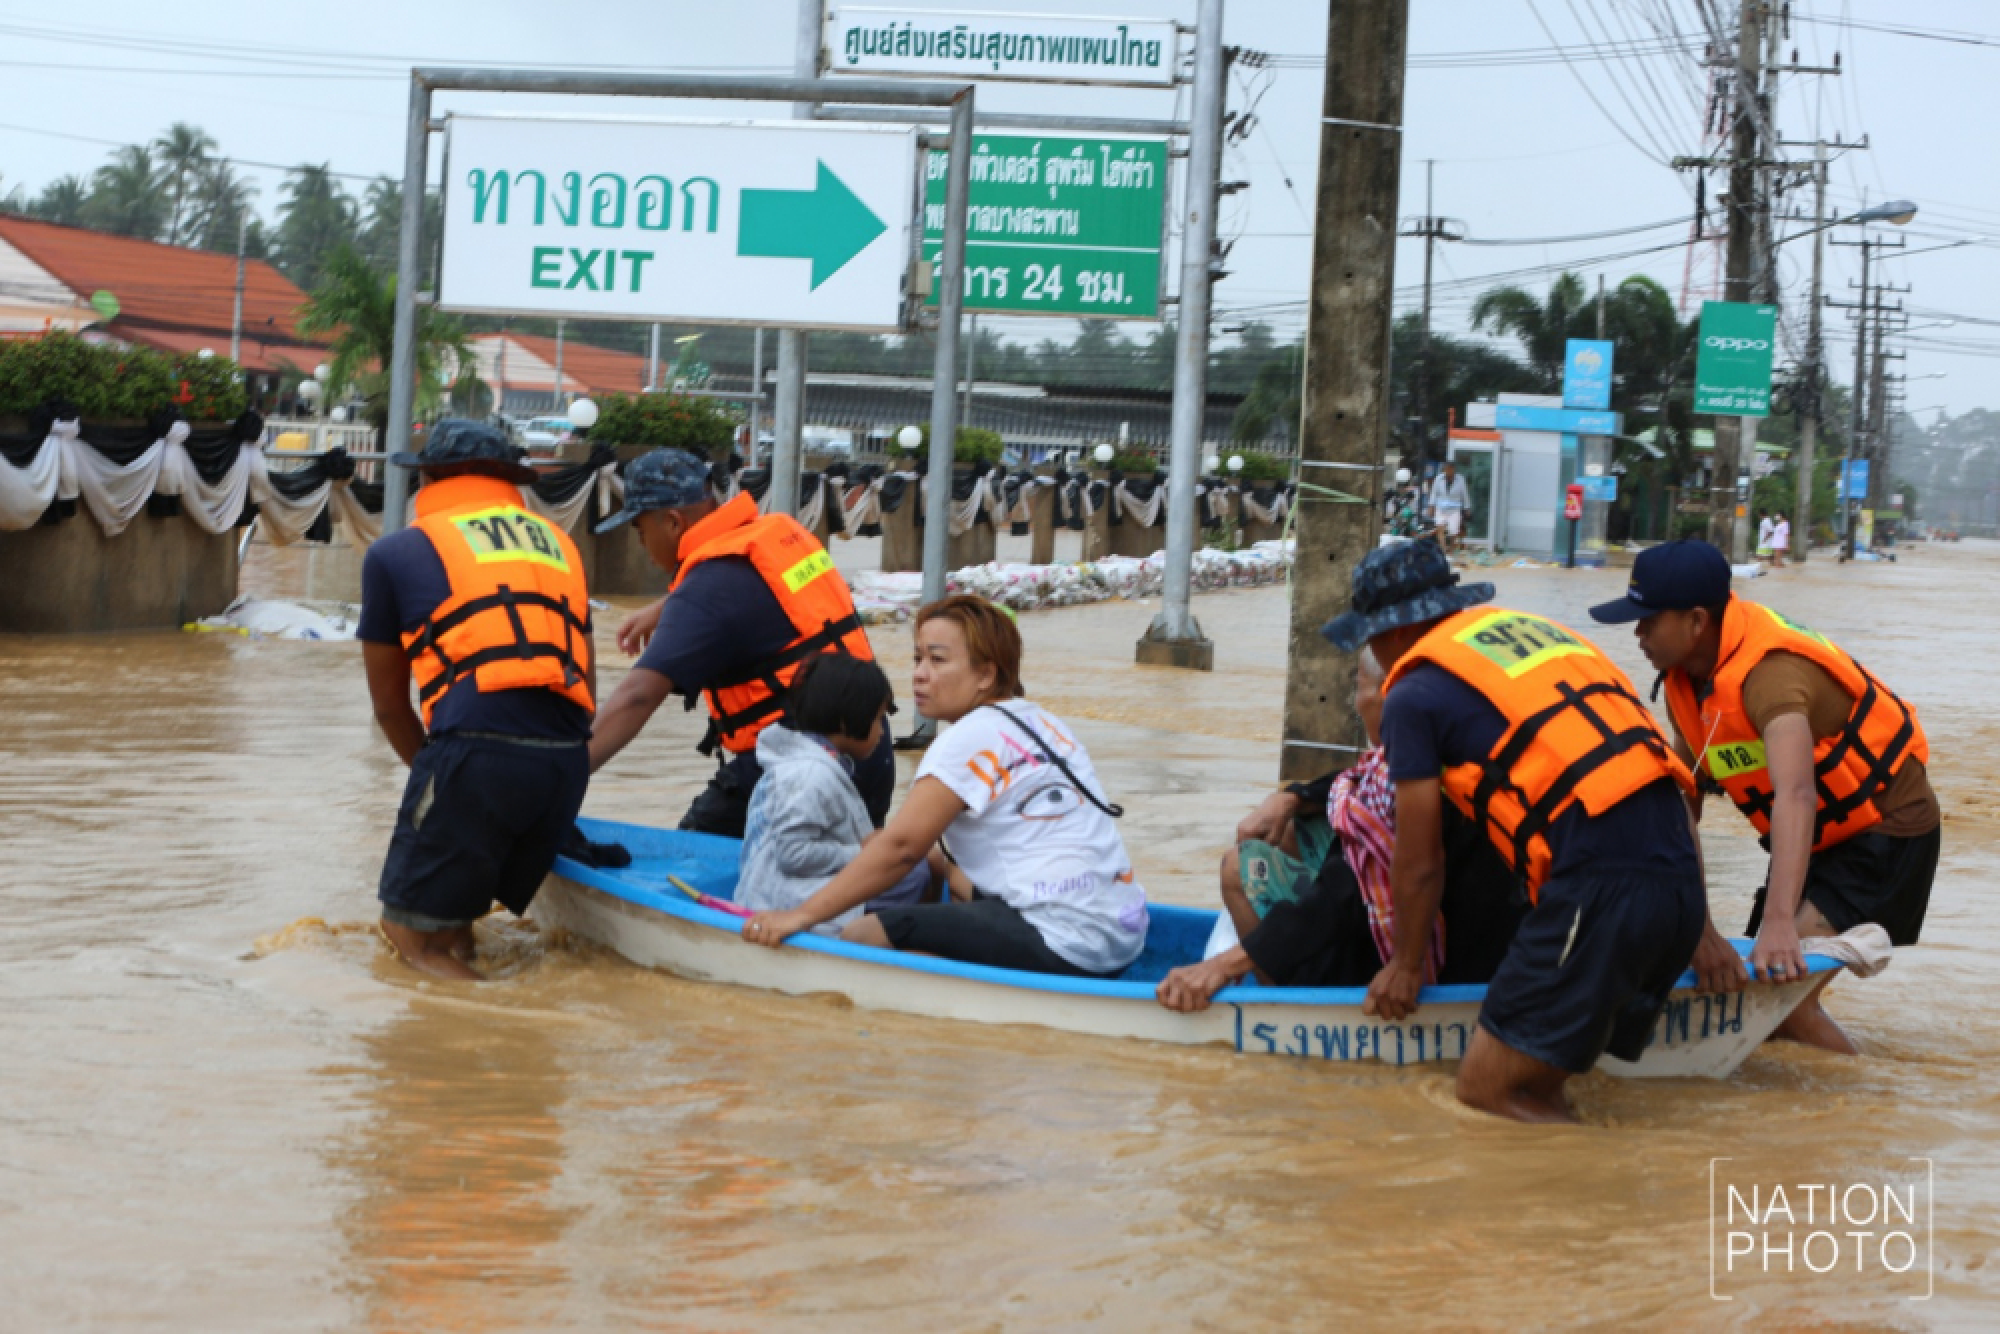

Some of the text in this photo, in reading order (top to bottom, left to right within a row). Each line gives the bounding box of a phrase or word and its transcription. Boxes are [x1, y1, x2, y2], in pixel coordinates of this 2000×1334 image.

[845, 20, 1161, 71] ศูนย์ส่งเสริมสุขภาพแผนไทย
[466, 166, 722, 234] ทางออก
[529, 245, 655, 294] EXIT
[1021, 262, 1065, 302] 24
[1075, 269, 1134, 305] ชม.
